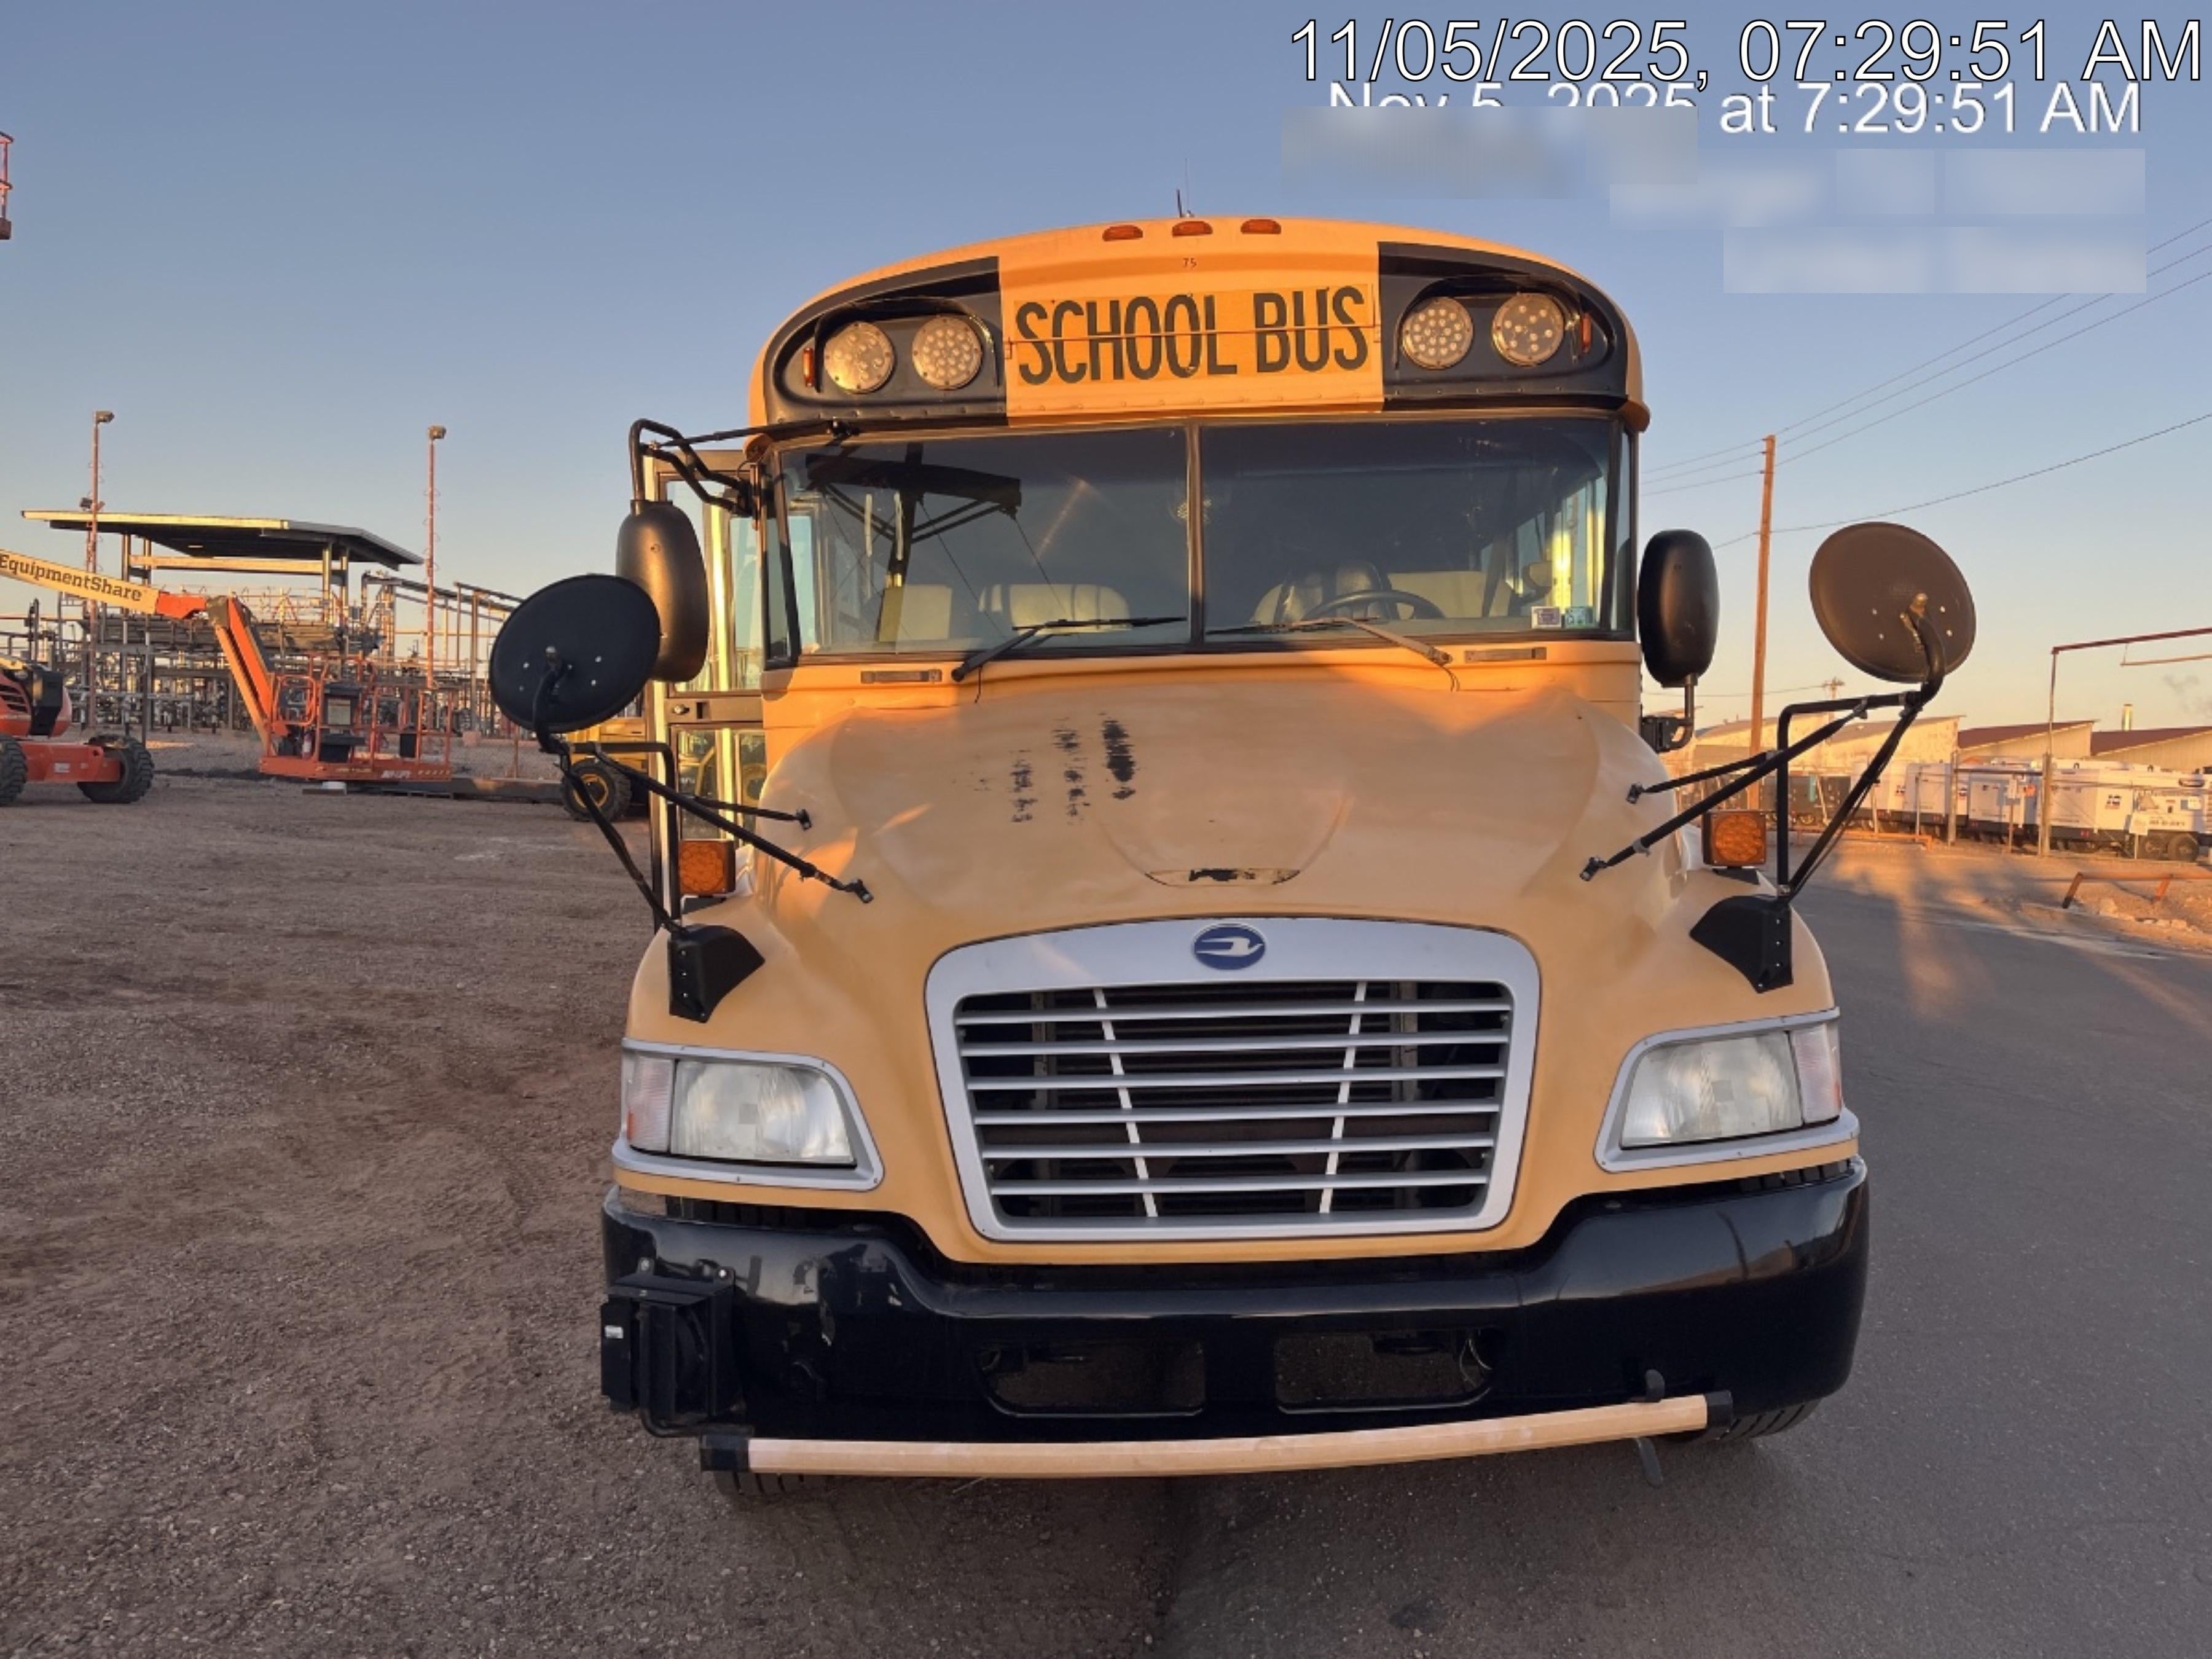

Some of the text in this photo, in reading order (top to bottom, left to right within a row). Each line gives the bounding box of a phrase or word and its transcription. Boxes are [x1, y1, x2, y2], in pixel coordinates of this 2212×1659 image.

[1182, 257, 1198, 269] 75
[1015, 285, 1368, 385] SCHOOL BUS
[0, 554, 143, 602] EquipmentShare
